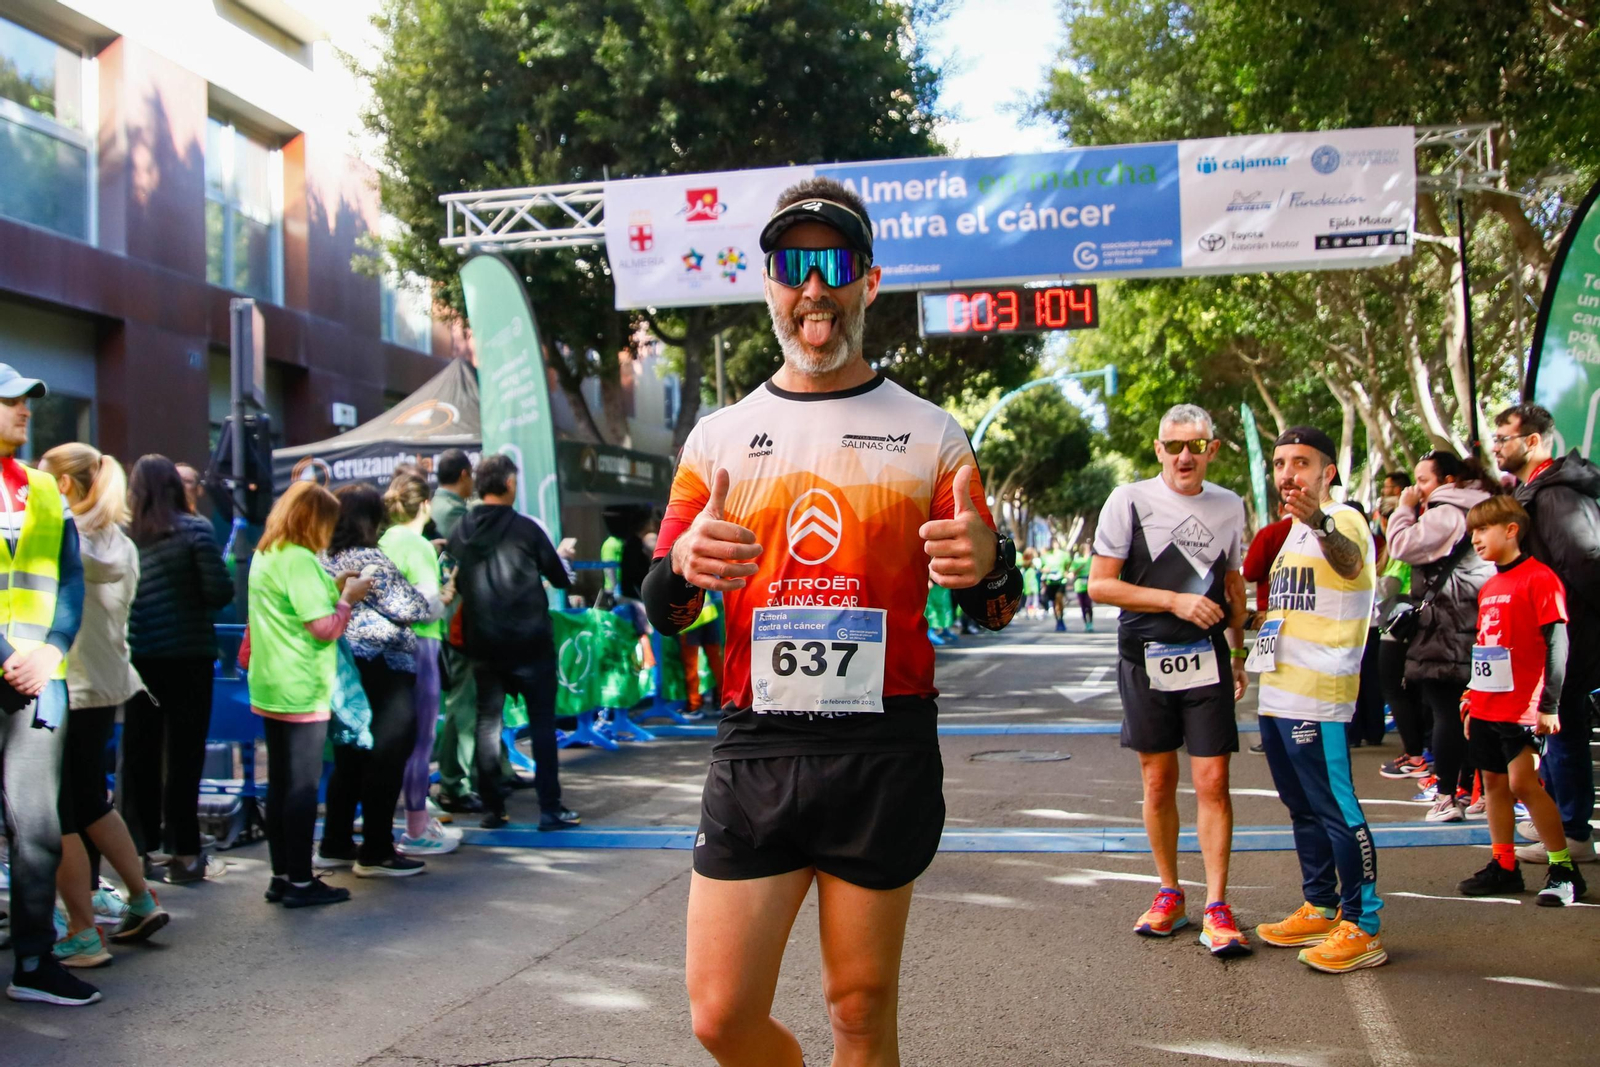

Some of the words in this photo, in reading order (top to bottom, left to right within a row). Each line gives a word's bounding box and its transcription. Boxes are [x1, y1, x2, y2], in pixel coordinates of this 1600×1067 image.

[1222, 155, 1290, 173] cajamar
[842, 171, 968, 205] Almería
[977, 172, 1018, 195] en
[1030, 160, 1158, 192] marcha
[956, 205, 990, 236] el
[997, 202, 1116, 234] cáncer
[1329, 217, 1356, 229] Ejido
[1360, 215, 1393, 225] Motor
[1231, 231, 1264, 240] Toyota
[1567, 329, 1598, 344] por
[841, 439, 884, 451] SALINAS
[886, 443, 907, 454] CAR
[766, 594, 825, 608] SALINAS
[829, 594, 859, 608] CAR
[758, 623, 781, 632] contra
[783, 622, 792, 630] el
[794, 621, 826, 630] cáncer
[1256, 636, 1276, 656] 1500
[772, 641, 859, 677] 637
[1160, 654, 1201, 675] 601
